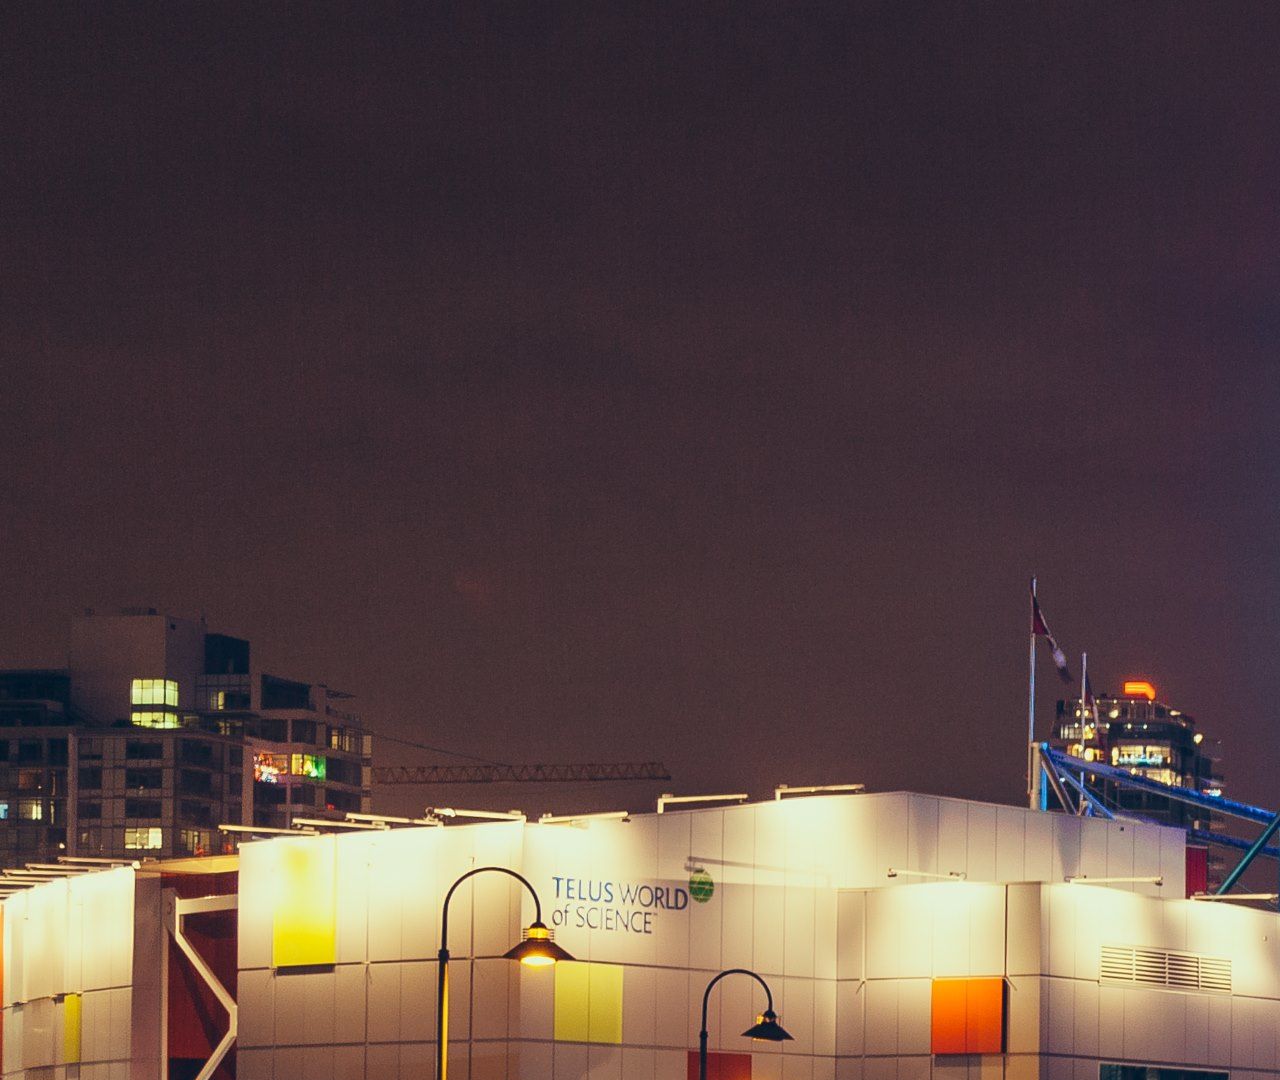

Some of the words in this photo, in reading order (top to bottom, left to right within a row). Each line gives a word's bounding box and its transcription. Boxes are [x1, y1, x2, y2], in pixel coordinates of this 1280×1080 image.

[552, 877, 613, 903] TELUS
[619, 883, 688, 910] WORLD
[552, 904, 569, 926] of
[576, 907, 653, 934] SCIENCE
